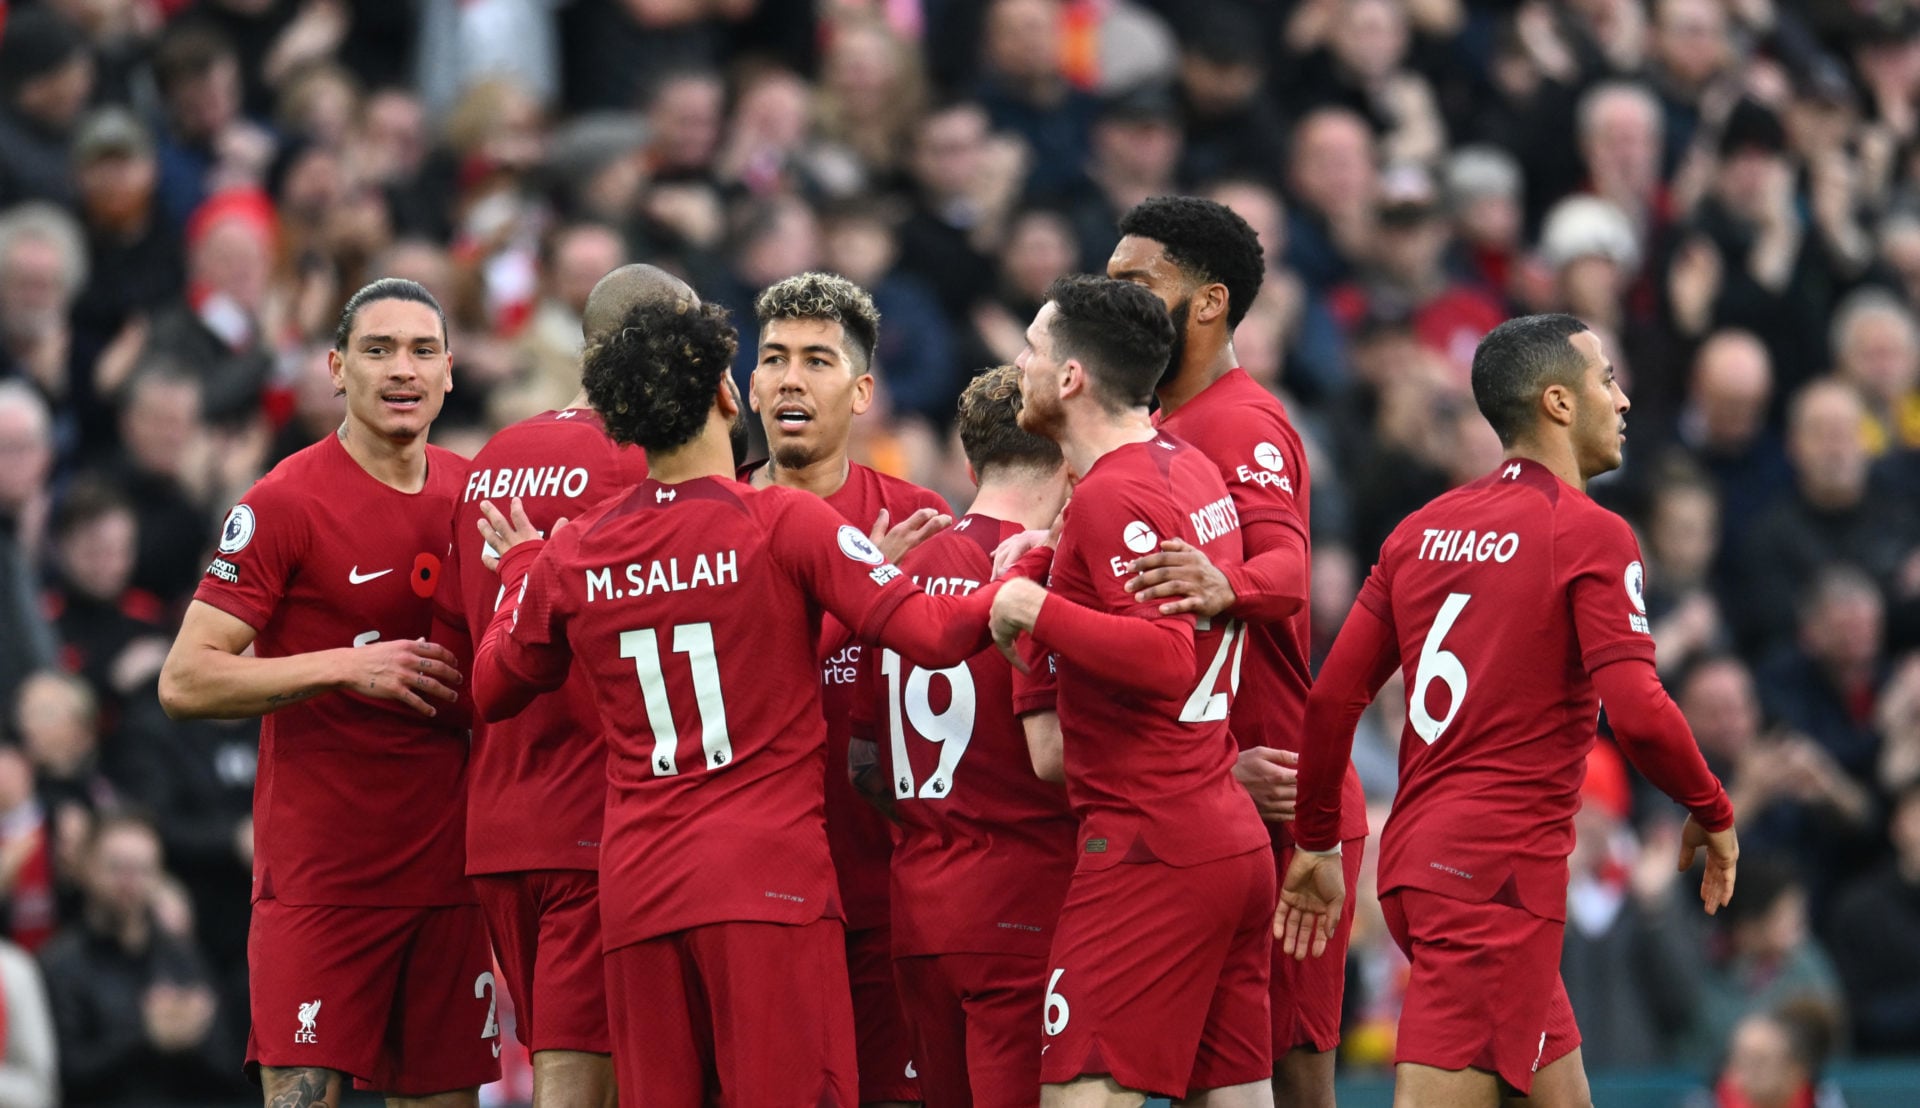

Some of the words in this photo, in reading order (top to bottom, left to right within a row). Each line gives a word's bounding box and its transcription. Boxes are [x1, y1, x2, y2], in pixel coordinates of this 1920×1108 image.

[464, 466, 588, 502] FABINHO
[586, 550, 738, 602] M.SALAH
[1418, 529, 1519, 563] THIAGO
[619, 621, 733, 777] 11
[1409, 592, 1472, 746] 6
[881, 647, 977, 800] 19
[1042, 968, 1070, 1037] 6
